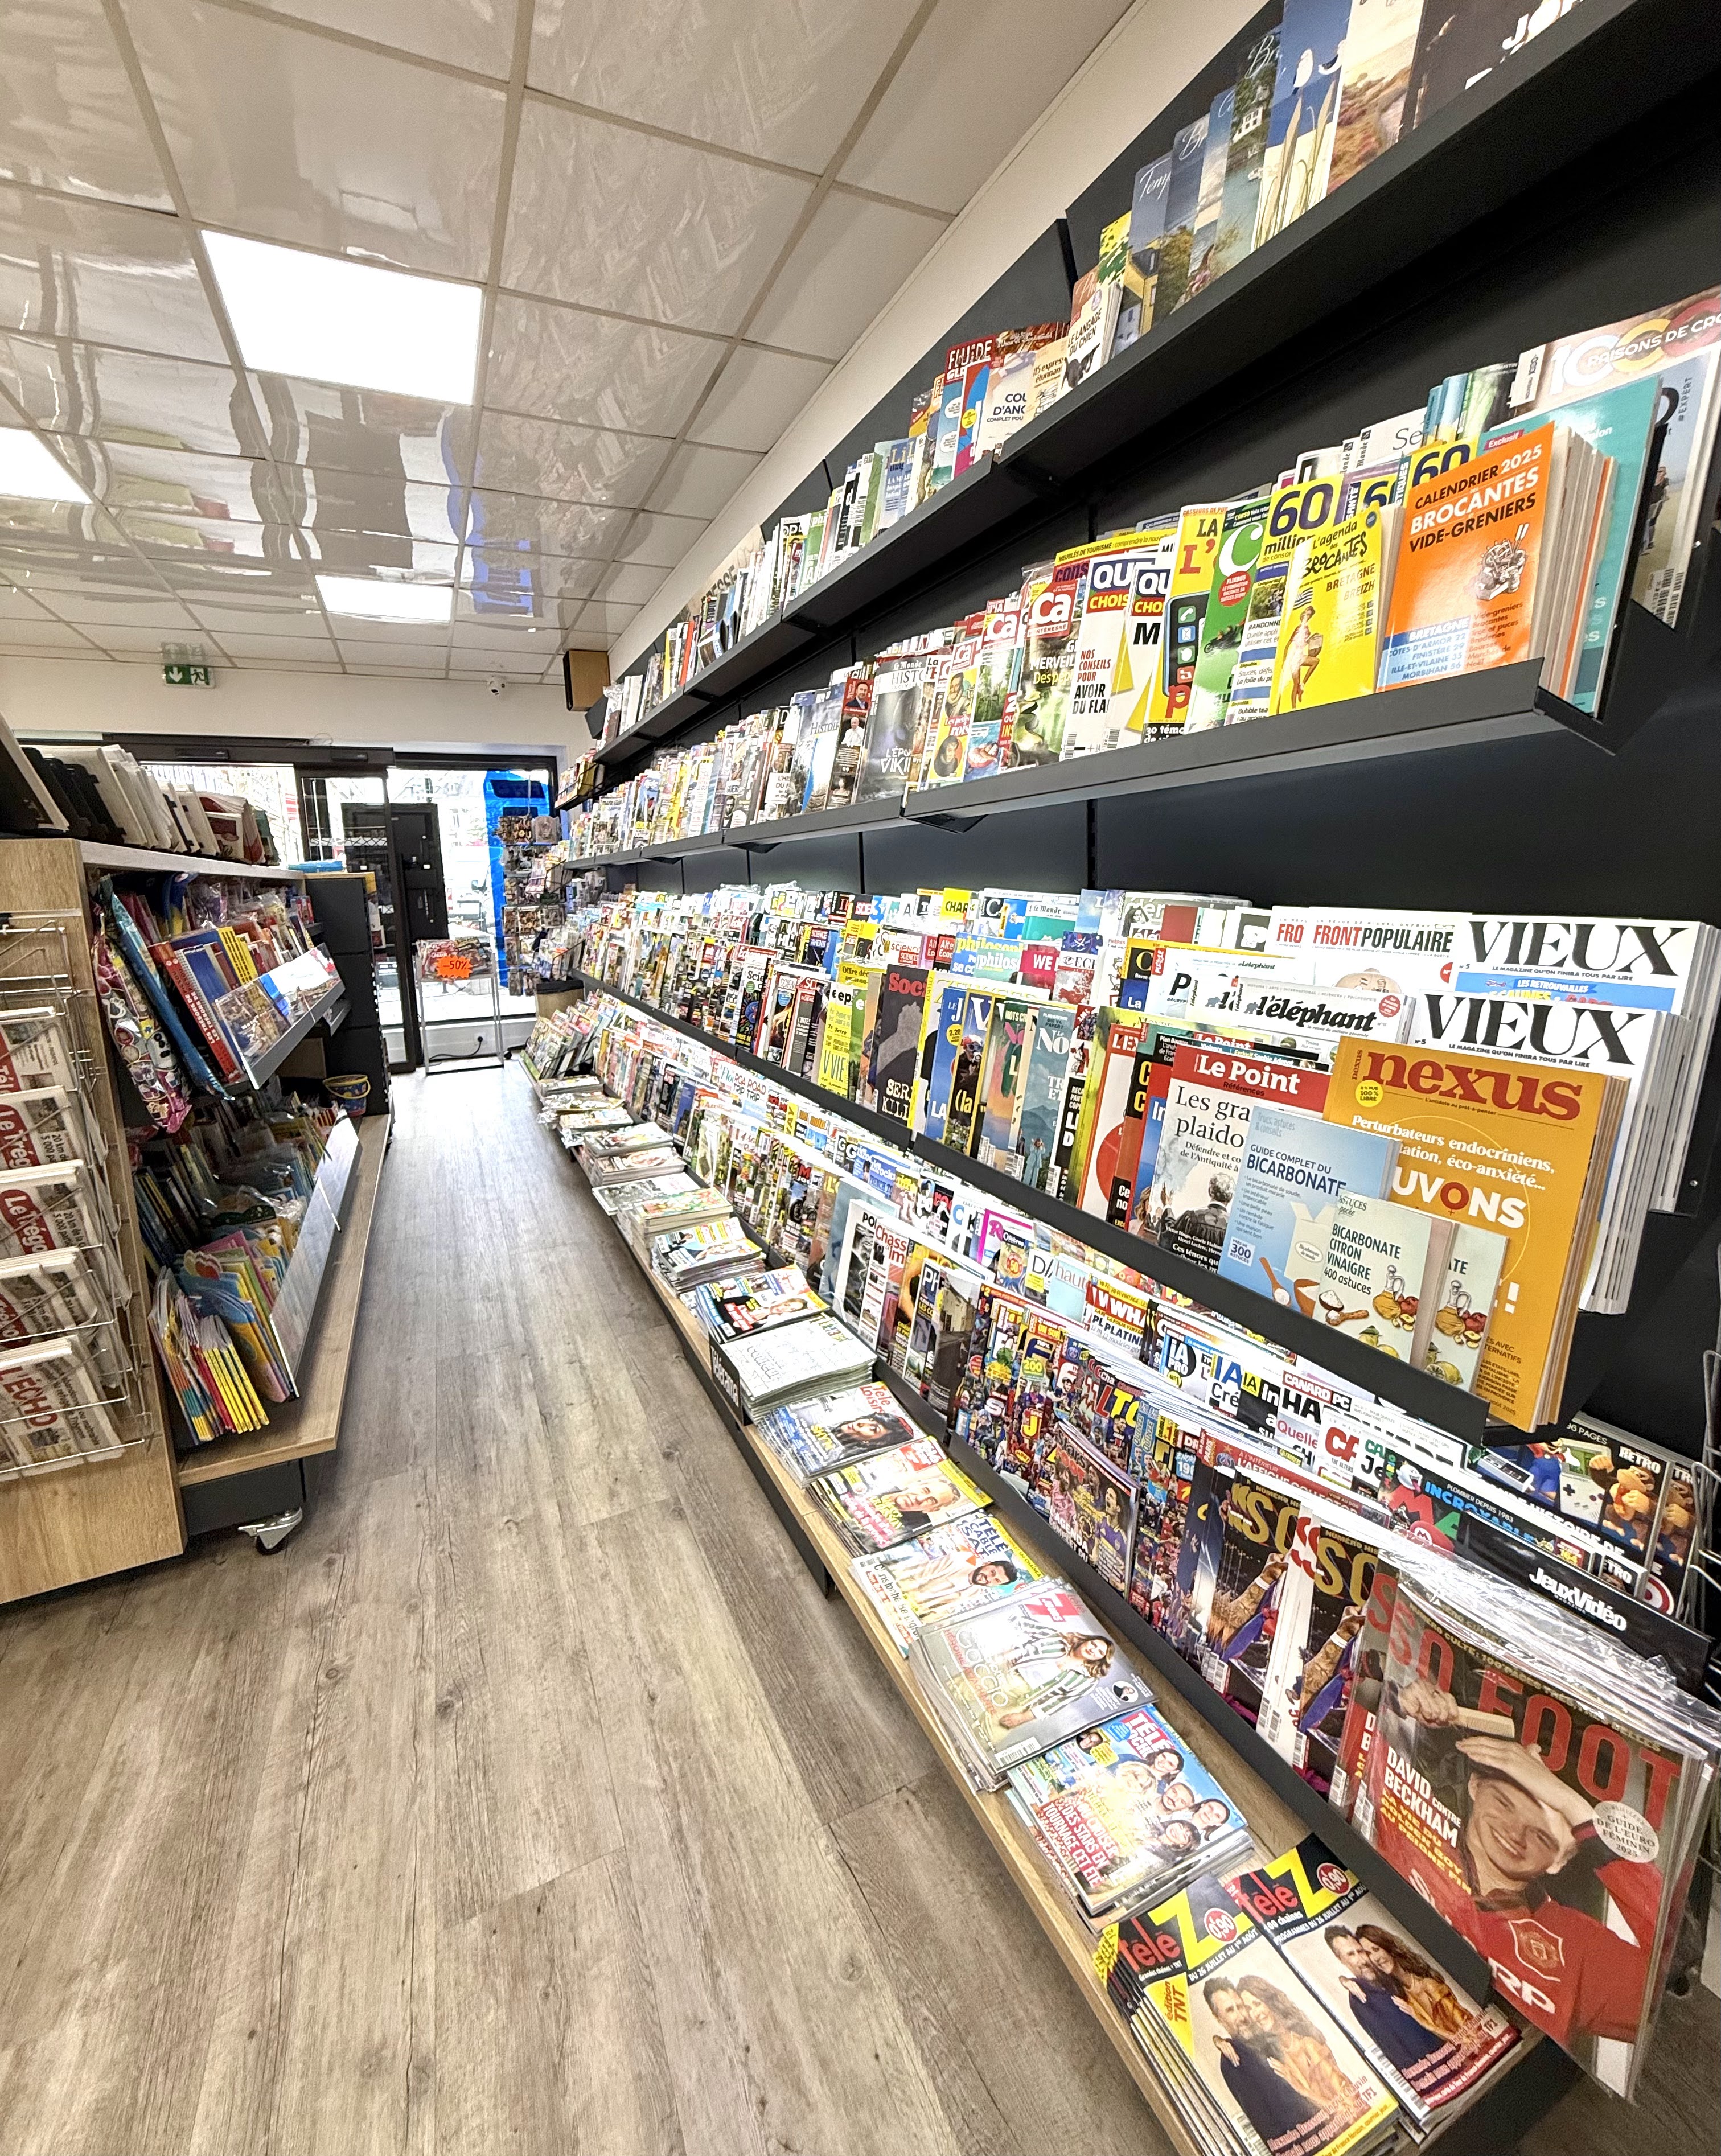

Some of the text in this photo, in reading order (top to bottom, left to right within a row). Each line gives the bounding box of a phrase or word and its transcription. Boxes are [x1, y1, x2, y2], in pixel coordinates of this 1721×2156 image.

[1588, 325, 1687, 367] RAISONS DE
[1488, 431, 1521, 450] Exclusif
[1415, 444, 1543, 509] CALENDRIER 2025
[1268, 484, 1336, 537] 60
[1410, 466, 1539, 535] BROCANTES
[1196, 518, 1218, 537] LA
[1312, 521, 1358, 550] L'agenda
[1409, 492, 1537, 553] VIDE-GRENIERS
[1058, 548, 1078, 562] MEUBLÉS
[1079, 547, 1087, 557] DE
[1087, 542, 1112, 554] TOURISME
[1326, 563, 1376, 592] BRETAGNE
[1344, 579, 1375, 601] BREIZH
[1408, 618, 1470, 642] BRETAGNE
[1081, 649, 1095, 660] NOS
[1453, 642, 1465, 651] 29
[1077, 671, 1096, 683] POUR
[1079, 659, 1111, 670] CONSEILS
[1391, 656, 1449, 674] ILLE-ET-VILAINE
[1402, 665, 1448, 680] MORBIHAN
[1074, 684, 1106, 699] AVOIR
[1072, 700, 1086, 715] DU
[1469, 921, 1689, 977] VIEUX
[1255, 995, 1377, 1033] l'éléphant
[1424, 994, 1647, 1066] VIEUX
[1456, 1044, 1491, 1054] MAGAZINE
[1515, 1052, 1538, 1061] FINIRA
[1197, 1053, 1301, 1095] Le Point
[1367, 1051, 1584, 1121] nexus
[1223, 1081, 1265, 1096] Références
[1176, 1085, 1251, 1122] Les gra
[1174, 1116, 1245, 1148] plaido
[1352, 1114, 1556, 1174] Perturbateurs endocriniens,
[1185, 1141, 1220, 1158] Défendre
[1189, 1151, 1233, 1172] l'Antiquité
[1250, 1143, 1332, 1175] GUIDE COMPLET DU
[1338, 1194, 1367, 1211] ASTUCES
[1172, 1243, 1185, 1253] Ces
[1186, 1248, 1208, 1262] ténors
[1230, 1244, 1251, 1259] 300
[1329, 1237, 1362, 1261] CITRON
[1332, 1223, 1402, 1260] BICARBONATE
[1229, 1253, 1250, 1264] ASTUCES
[1326, 1252, 1371, 1281] VINAIGRE
[1323, 1267, 1373, 1295] 400 astuces
[1495, 1340, 1515, 1353] AVEC
[1168, 1356, 1189, 1376] PRO
[1284, 1372, 1350, 1410] CANARD PC
[1579, 1425, 1608, 1445] PAGES
[1619, 1446, 1661, 1474] RETRO
[1447, 1483, 1514, 1523] PLOMBIER DEPUIS 1983
[1529, 1568, 1627, 1632] JeuxVidéo
[1478, 1665, 1681, 1833] FOOT
[1387, 1745, 1461, 1828] DAVID CONTRE
[1383, 1766, 1459, 1848] BECKHAM
[1043, 1803, 1092, 1869] TOURNAGE CET
[1607, 1814, 1642, 1833] GUIDE
[1615, 1825, 1656, 1847] L'EURO
[1073, 1823, 1099, 1853] STARS
[1272, 1924, 1310, 1945] PROGRAMMES
[1323, 1902, 1342, 1922] JUILLET
[1173, 1985, 1187, 2022] TNT
